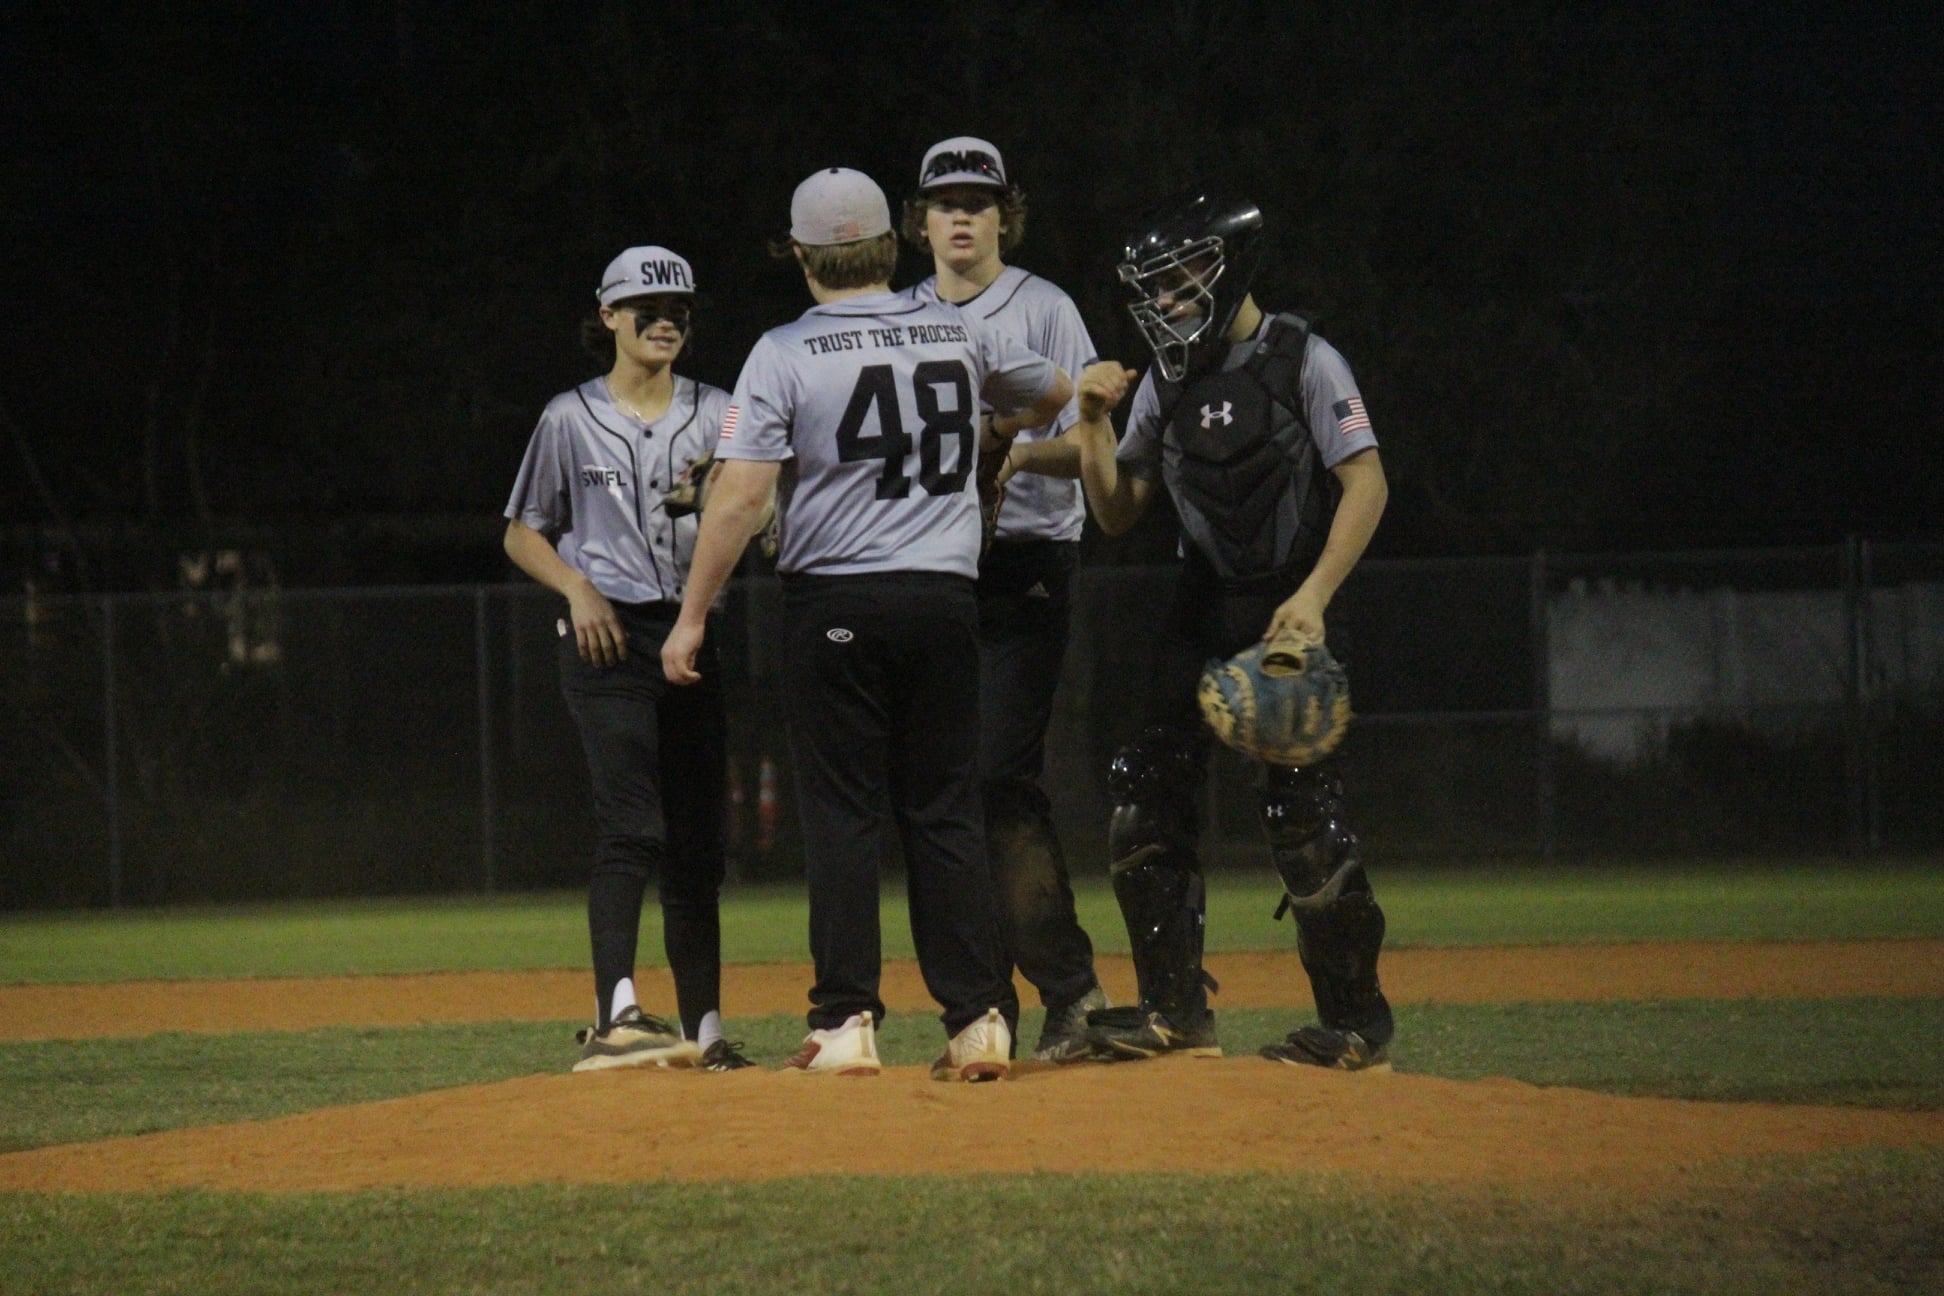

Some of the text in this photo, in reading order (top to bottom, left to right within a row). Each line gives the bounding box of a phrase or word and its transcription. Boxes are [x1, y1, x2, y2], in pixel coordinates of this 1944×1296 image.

[640, 259, 690, 289] SWFL
[804, 324, 968, 355] TRUST THE PROCESS
[835, 359, 974, 500] 48
[582, 470, 627, 487] SWFL
